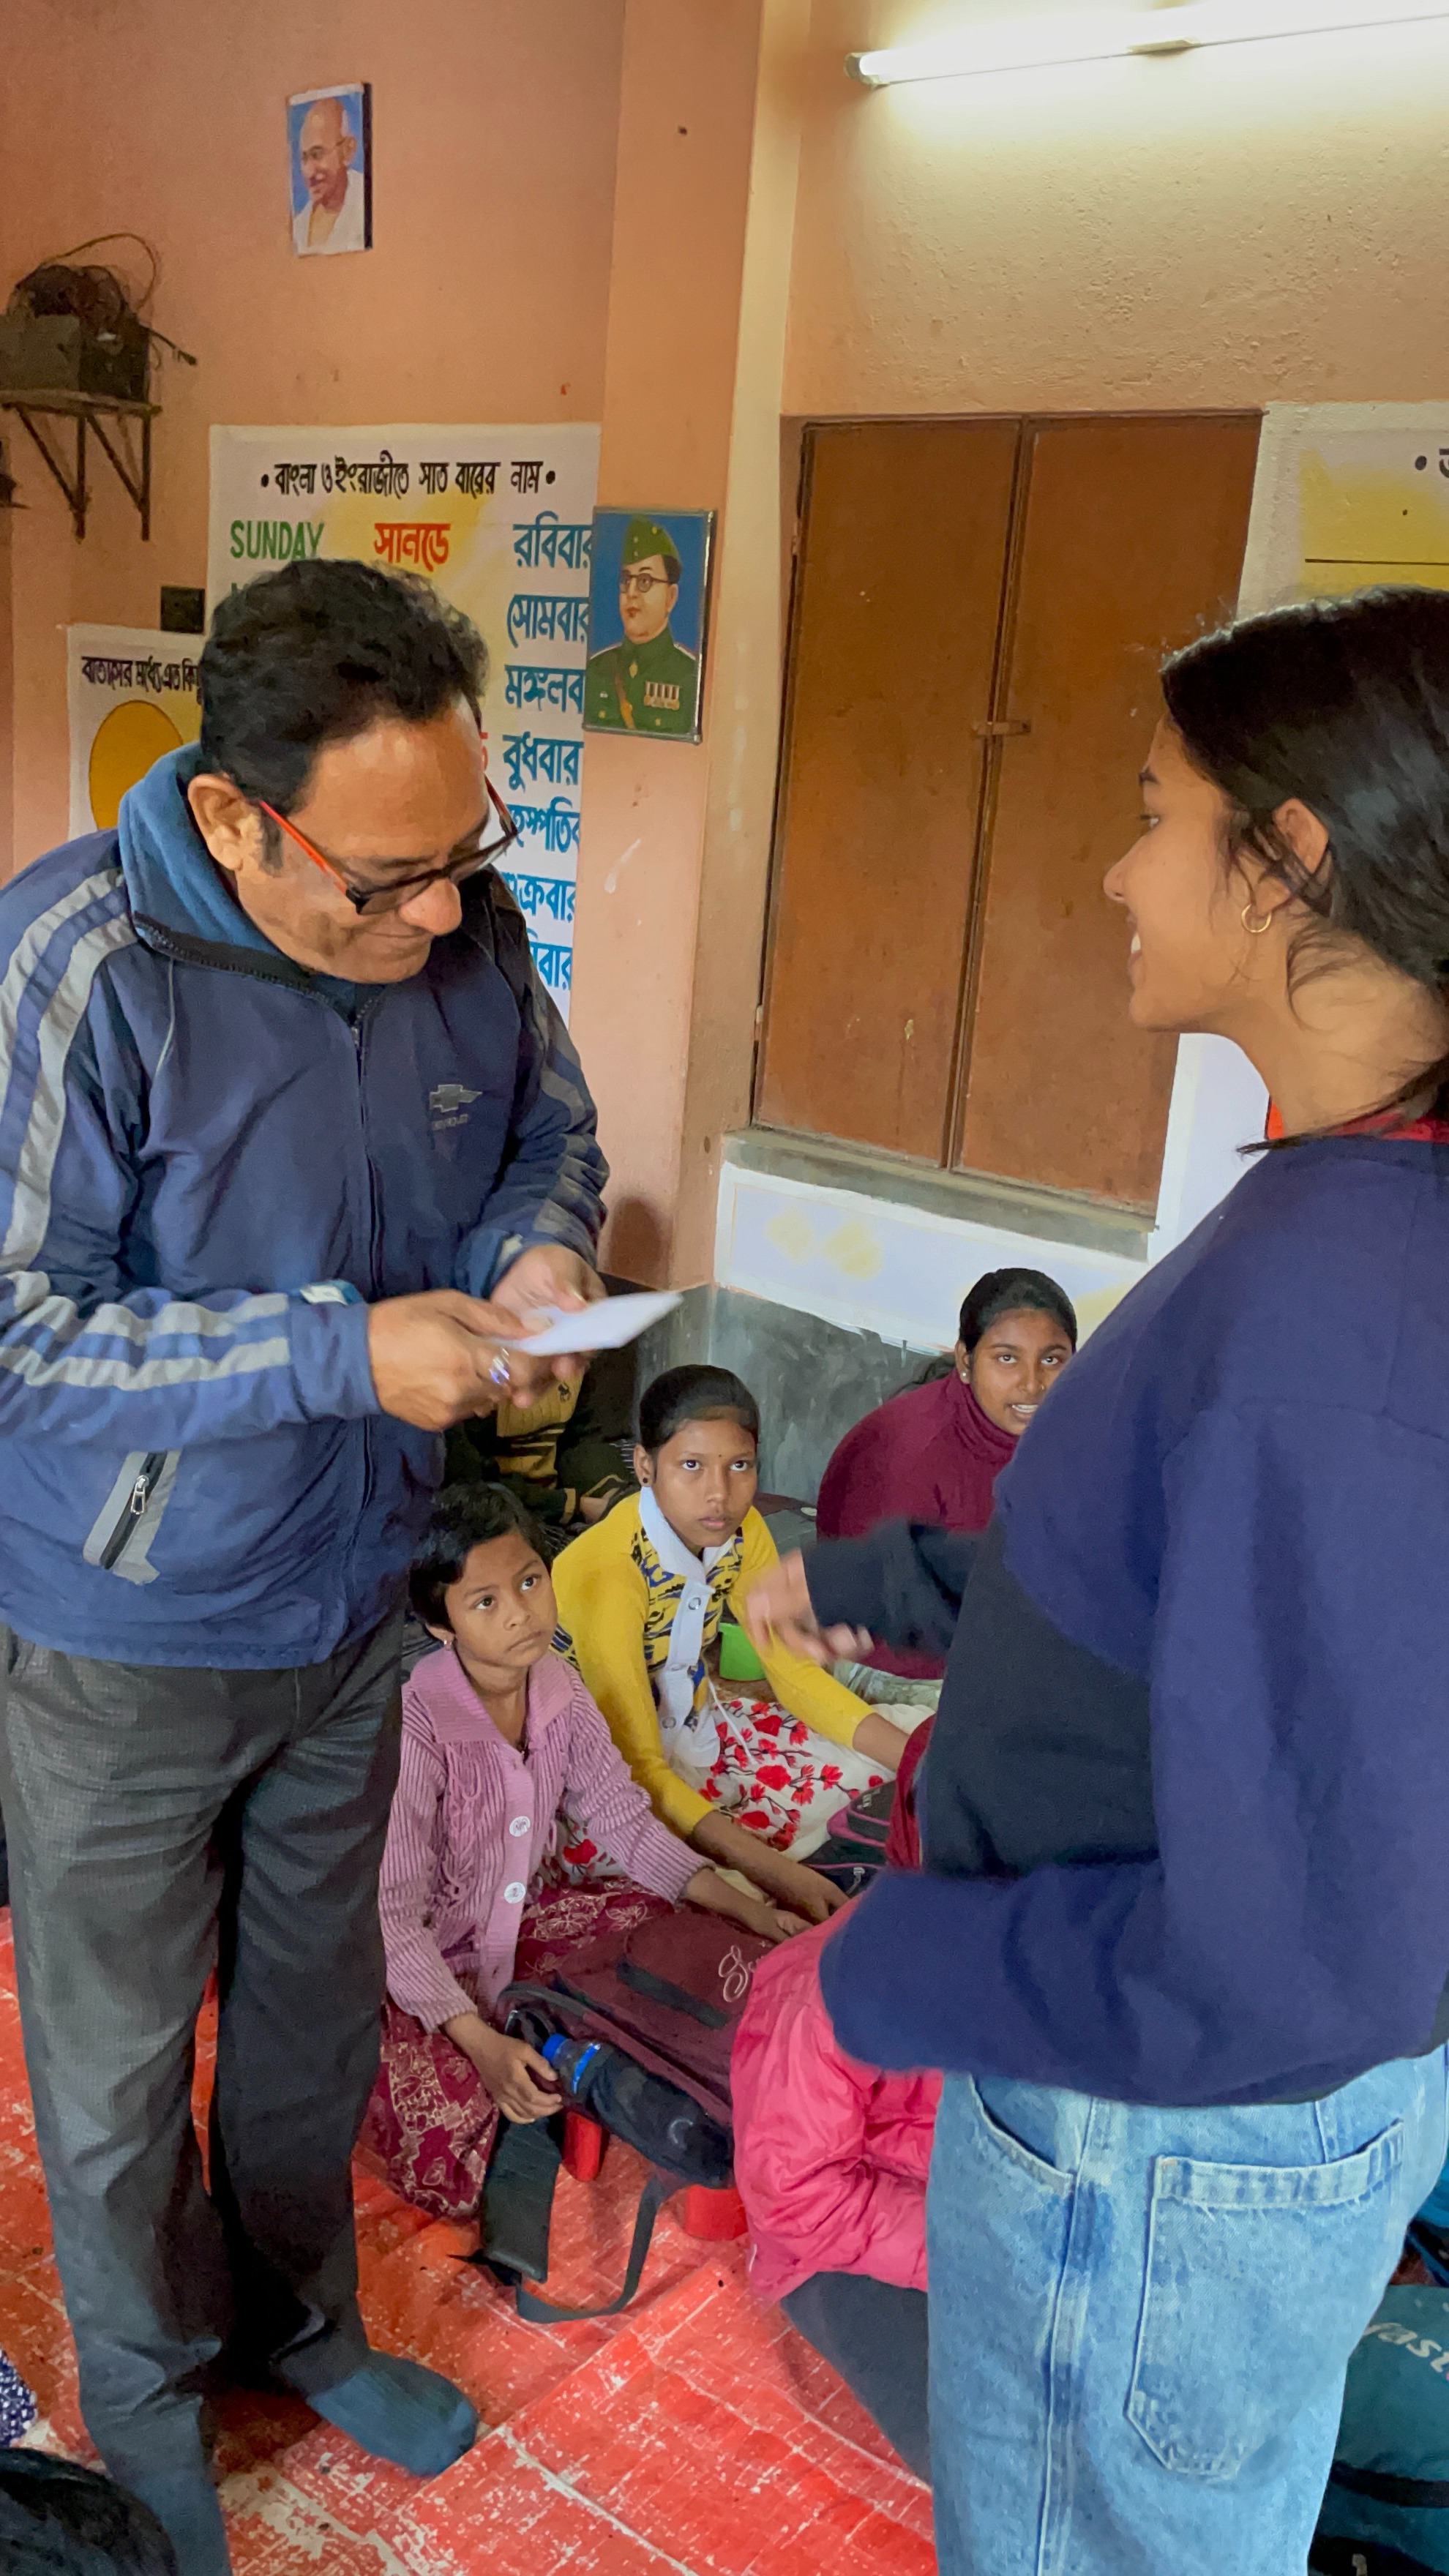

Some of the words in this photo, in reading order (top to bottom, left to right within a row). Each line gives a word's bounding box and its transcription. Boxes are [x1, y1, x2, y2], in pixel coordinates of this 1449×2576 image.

[419, 462, 449, 495] সাত
[455, 461, 501, 499] বারের
[511, 461, 544, 493] নাম
[231, 520, 325, 560] SUNDAY
[374, 523, 451, 572] সানডে
[504, 664, 585, 714] মঙ্গলব
[503, 731, 585, 794] বুধবার
